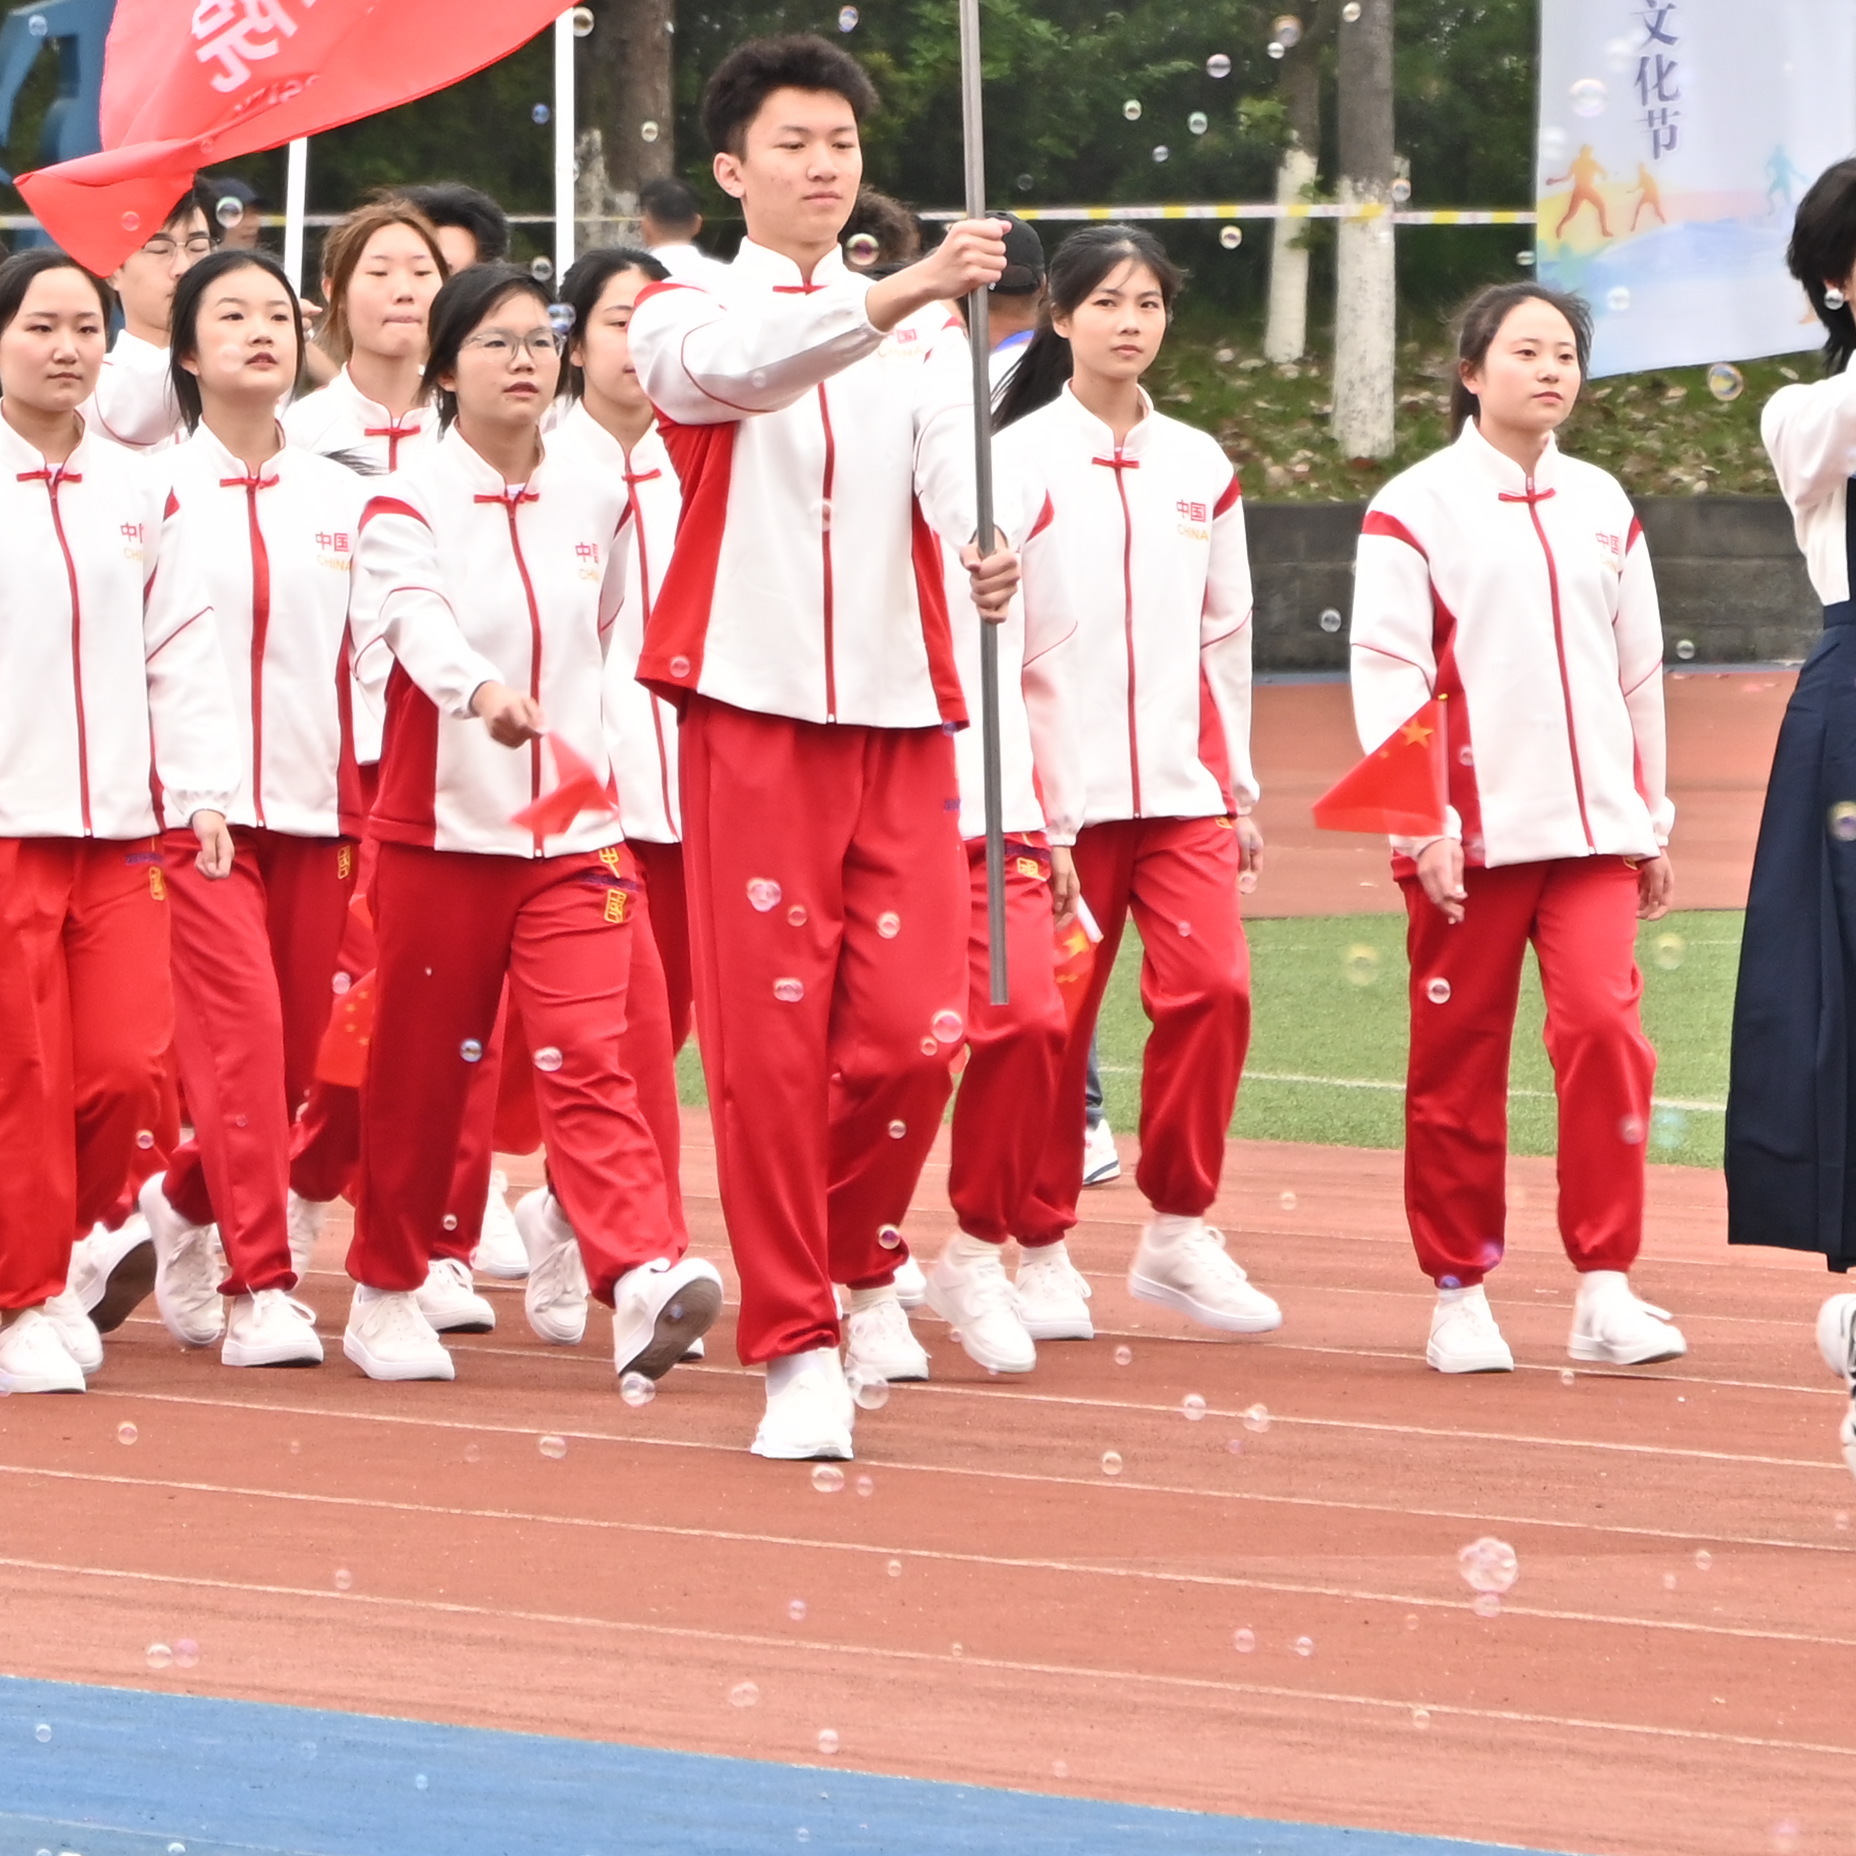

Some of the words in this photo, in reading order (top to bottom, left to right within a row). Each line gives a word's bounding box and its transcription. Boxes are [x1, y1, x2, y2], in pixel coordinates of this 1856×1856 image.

[1176, 499, 1207, 523] 中国
[315, 531, 350, 553] 中国
[1177, 524, 1210, 541] CHINA
